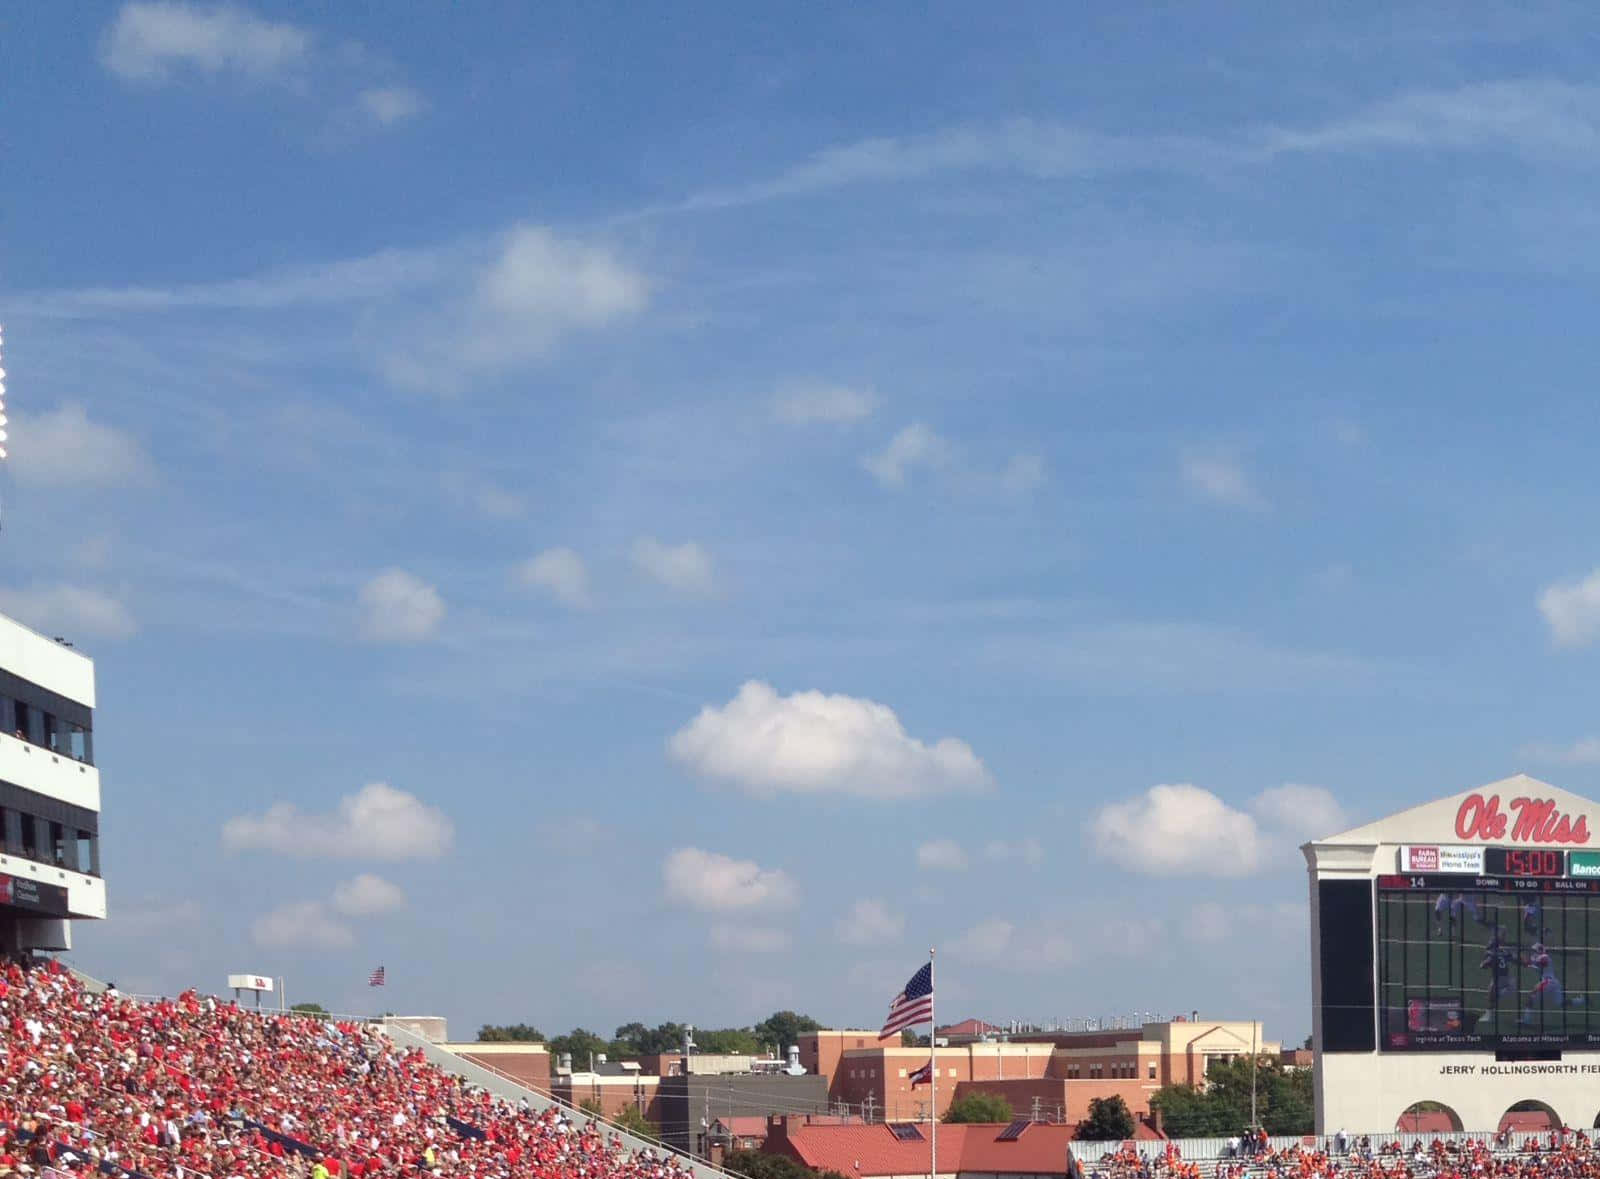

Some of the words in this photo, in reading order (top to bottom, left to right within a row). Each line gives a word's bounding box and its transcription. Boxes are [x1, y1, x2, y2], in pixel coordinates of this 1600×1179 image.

[1455, 794, 1507, 840] Ole
[1510, 797, 1590, 844] Miss
[1506, 850, 1556, 874] 15:00
[1410, 876, 1425, 888] 14
[1476, 879, 1499, 887] DOWN
[1515, 880, 1525, 888] TO
[1440, 1065, 1475, 1075] JERRY
[1481, 1065, 1578, 1075] HOLLINGSWORTH
